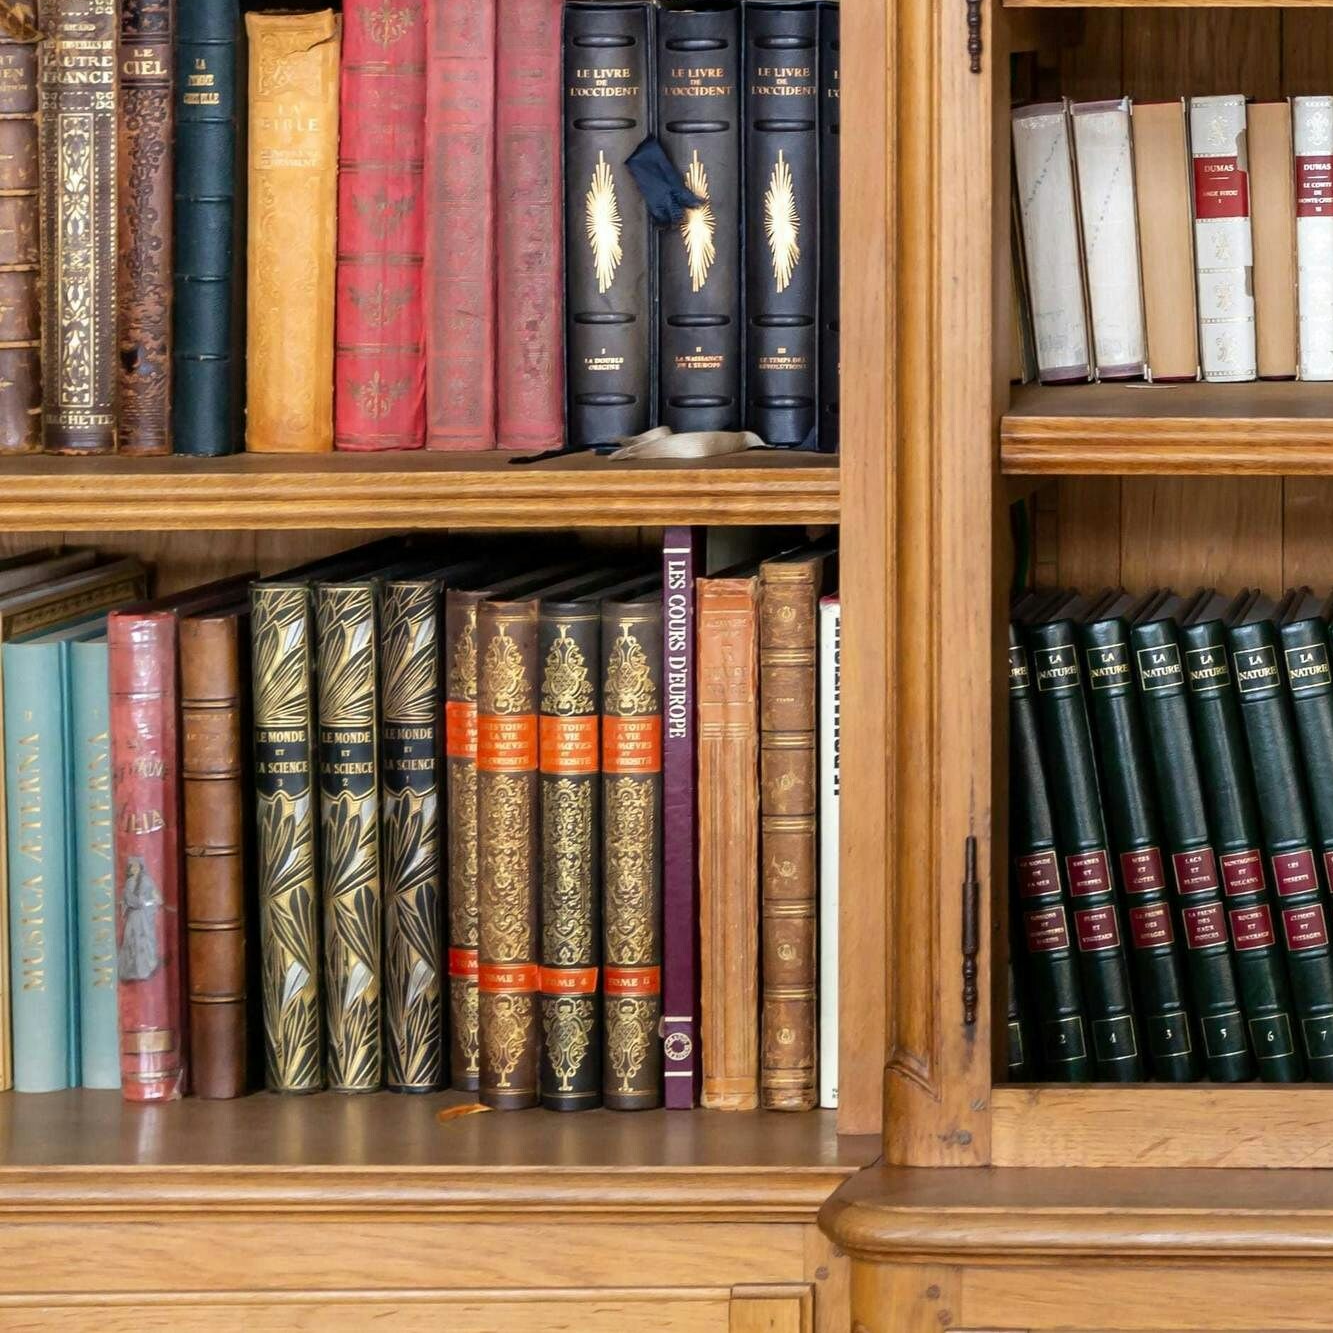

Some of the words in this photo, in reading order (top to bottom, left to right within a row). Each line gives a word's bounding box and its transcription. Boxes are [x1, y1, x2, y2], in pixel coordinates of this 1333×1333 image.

[134, 49, 154, 57] LE
[124, 61, 168, 75] CIEL
[577, 69, 591, 78] LE
[594, 69, 630, 78] LIVRE
[42, 72, 114, 84] FRANCE
[570, 87, 639, 97] L'OCCIDENT
[263, 119, 318, 131] BIBLE
[669, 560, 685, 589] LES
[669, 594, 685, 648] COURS
[1153, 654, 1166, 664] LA
[1143, 665, 1180, 678] NATURE
[669, 652, 686, 739] D'EUROPE
[257, 732, 267, 742] LE
[268, 731, 306, 742] MONDE
[268, 761, 308, 773] SCIENCE
[23, 875, 46, 993] MUSICA
[1320, 1030, 1327, 1041] 7
